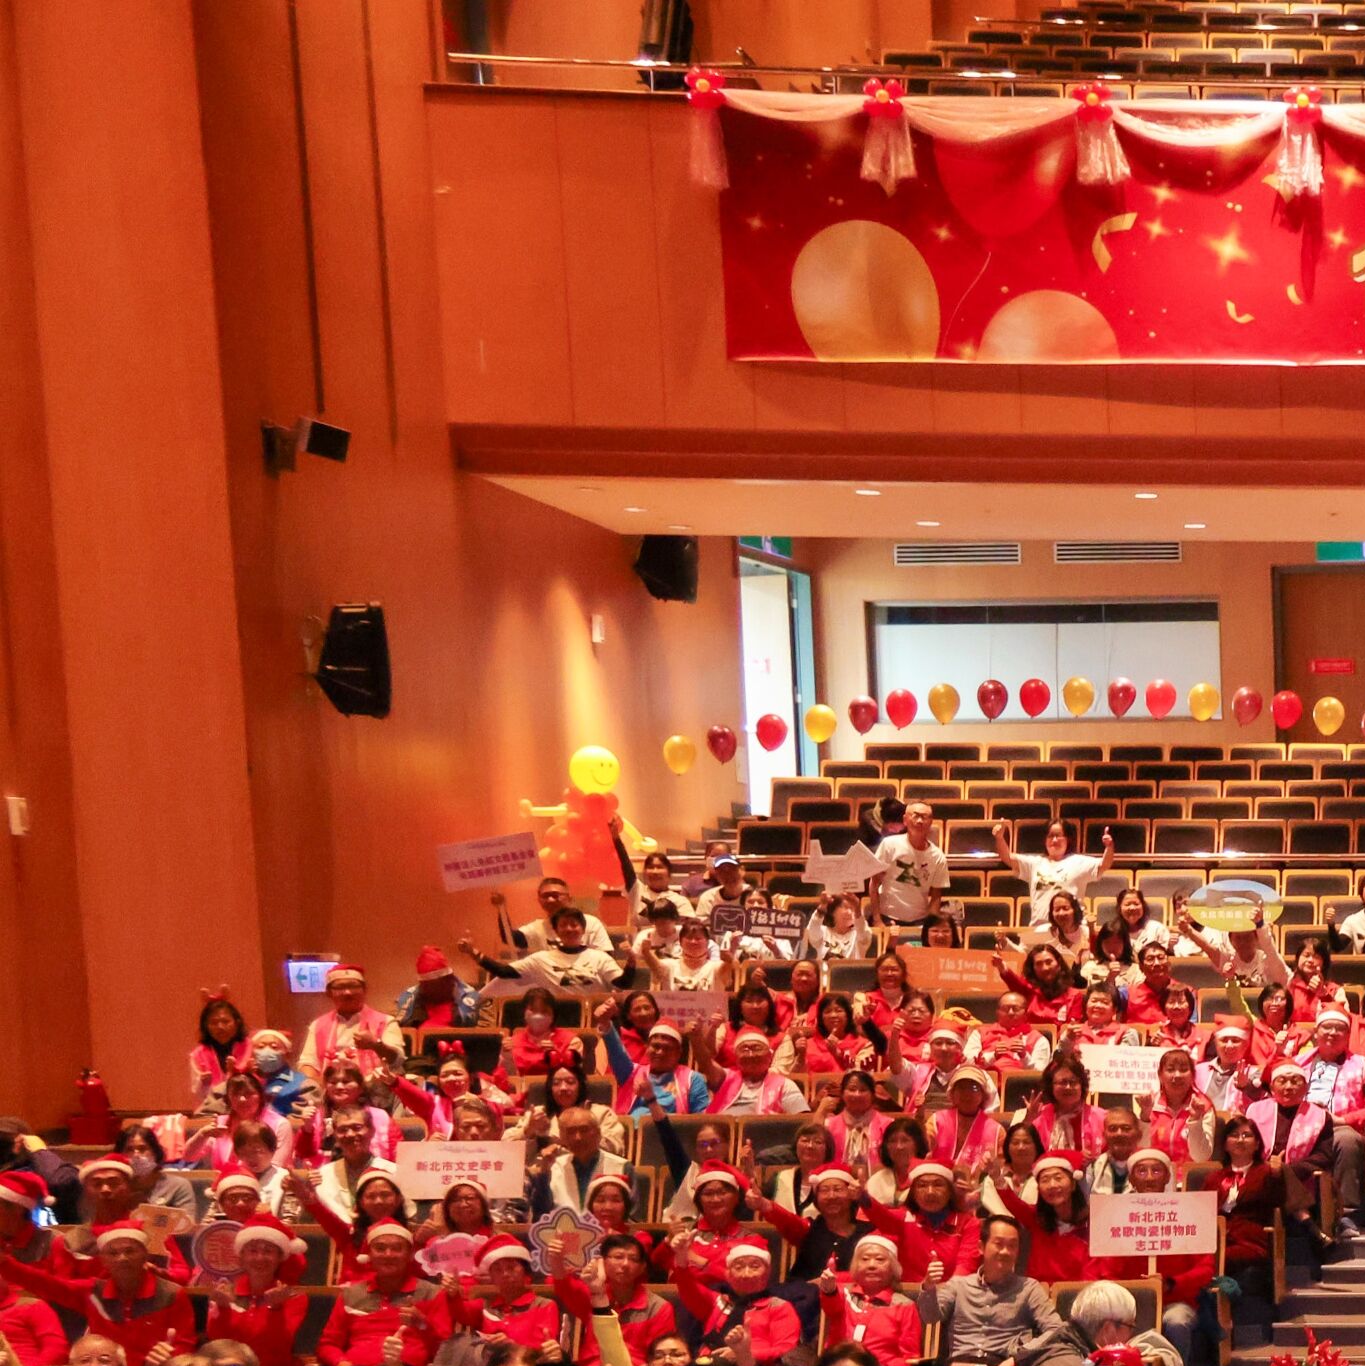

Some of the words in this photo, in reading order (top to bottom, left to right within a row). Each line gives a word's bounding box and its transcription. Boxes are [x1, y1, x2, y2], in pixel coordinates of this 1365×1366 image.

[415, 1160, 504, 1173] 新北市文史學會
[1128, 1210, 1178, 1223] 新北市立
[1110, 1224, 1197, 1238] 鶯歌陶瓷博物館
[1135, 1239, 1172, 1252] 志工隊
